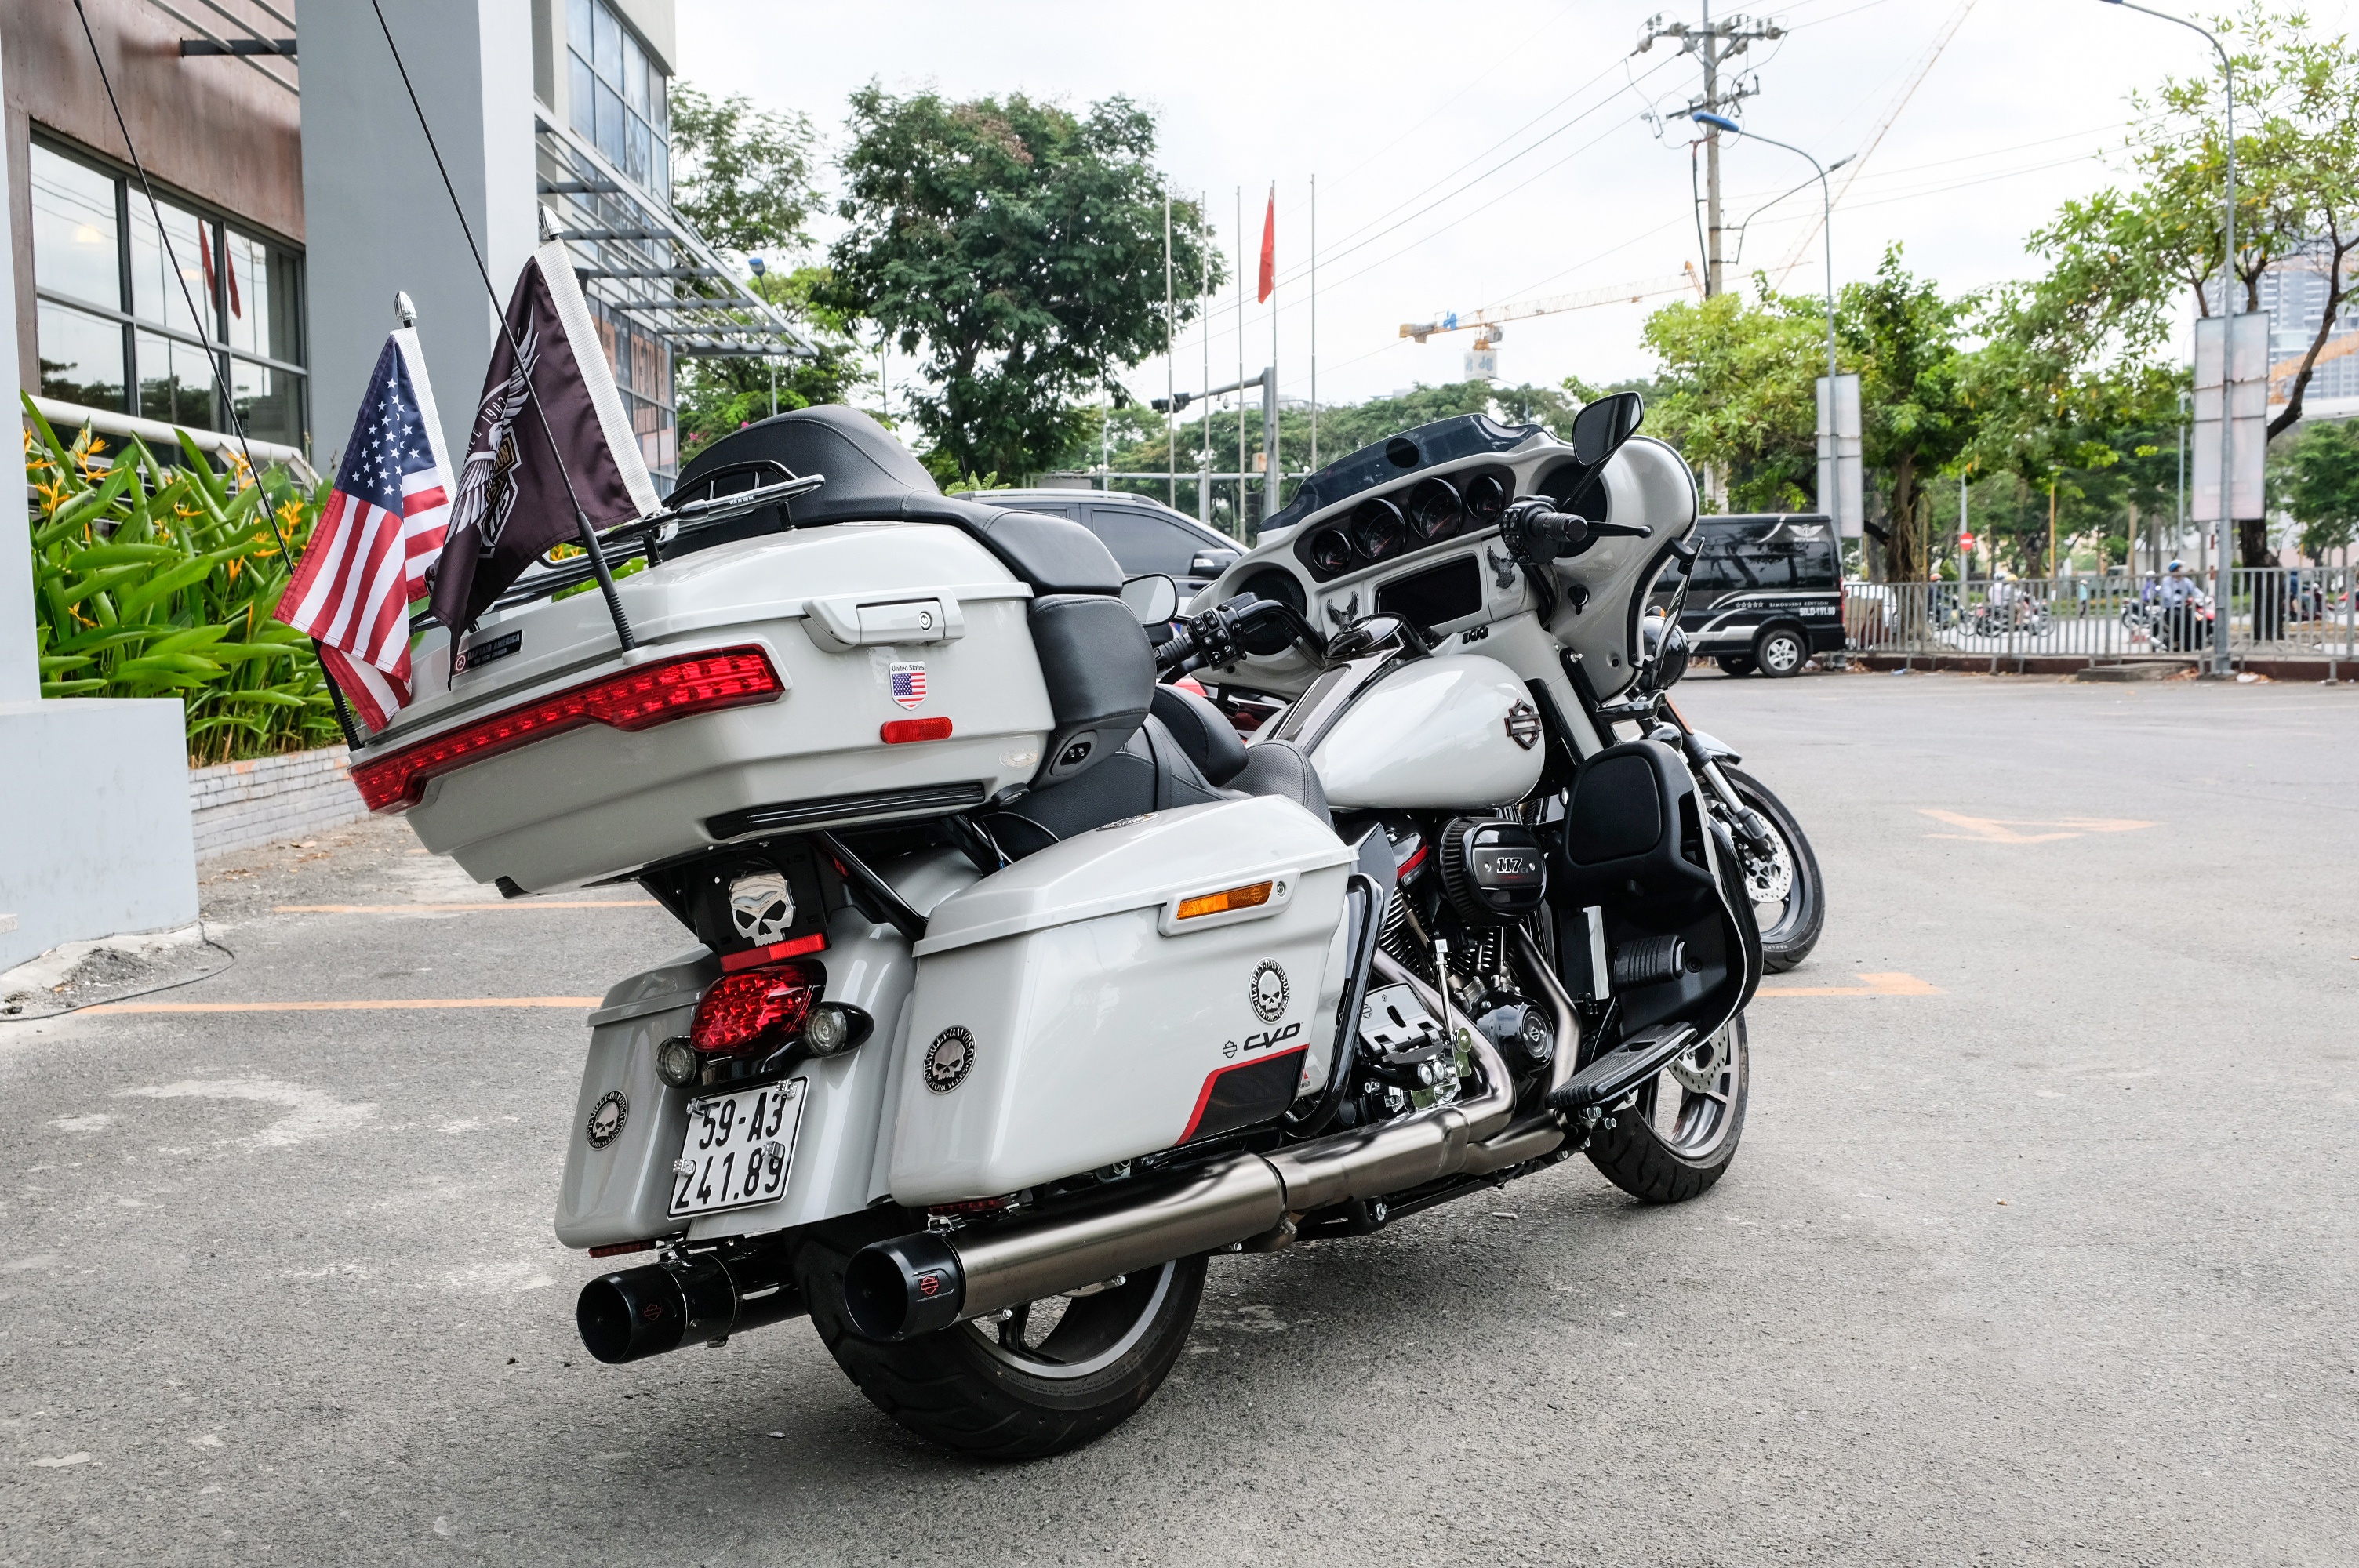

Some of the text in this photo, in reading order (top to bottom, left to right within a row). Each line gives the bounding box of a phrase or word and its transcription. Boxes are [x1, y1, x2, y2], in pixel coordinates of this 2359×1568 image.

[467, 633, 520, 660] CAPTAIN AMERICA
[1497, 857, 1522, 873] 117
[1243, 1022, 1301, 1051] CVO
[699, 1092, 787, 1150] 59-A3
[674, 1145, 785, 1210] 241.89
